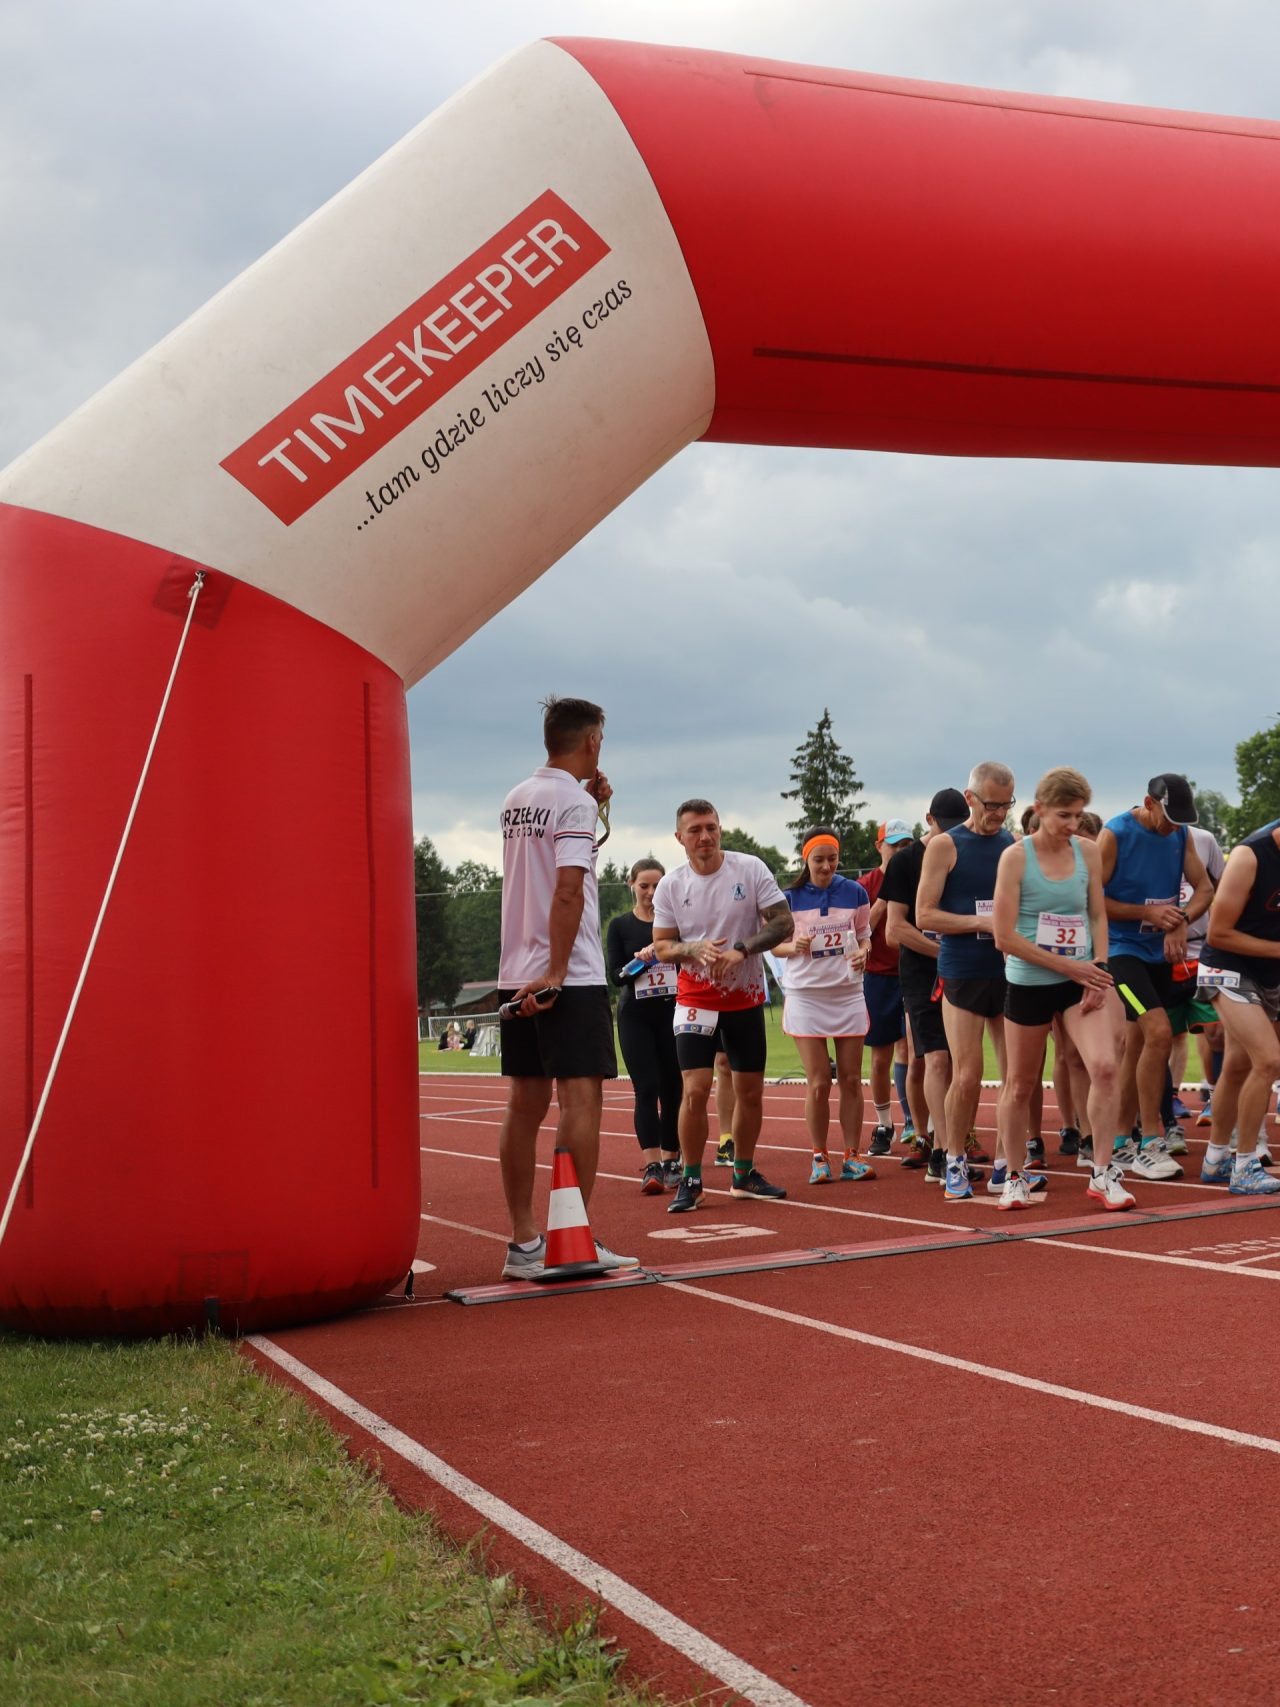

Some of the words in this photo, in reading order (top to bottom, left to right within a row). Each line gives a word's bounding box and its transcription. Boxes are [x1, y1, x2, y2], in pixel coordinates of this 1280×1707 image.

[257, 218, 580, 483] TIMEKEEPER
[356, 464, 420, 531] ...tam
[421, 406, 486, 474] gdzie
[481, 354, 546, 413] liczy
[545, 323, 582, 362] się
[582, 279, 633, 329] czas
[824, 933, 842, 948] 22
[1056, 928, 1076, 944] 32
[648, 972, 666, 986] 12
[687, 1008, 697, 1022] 8
